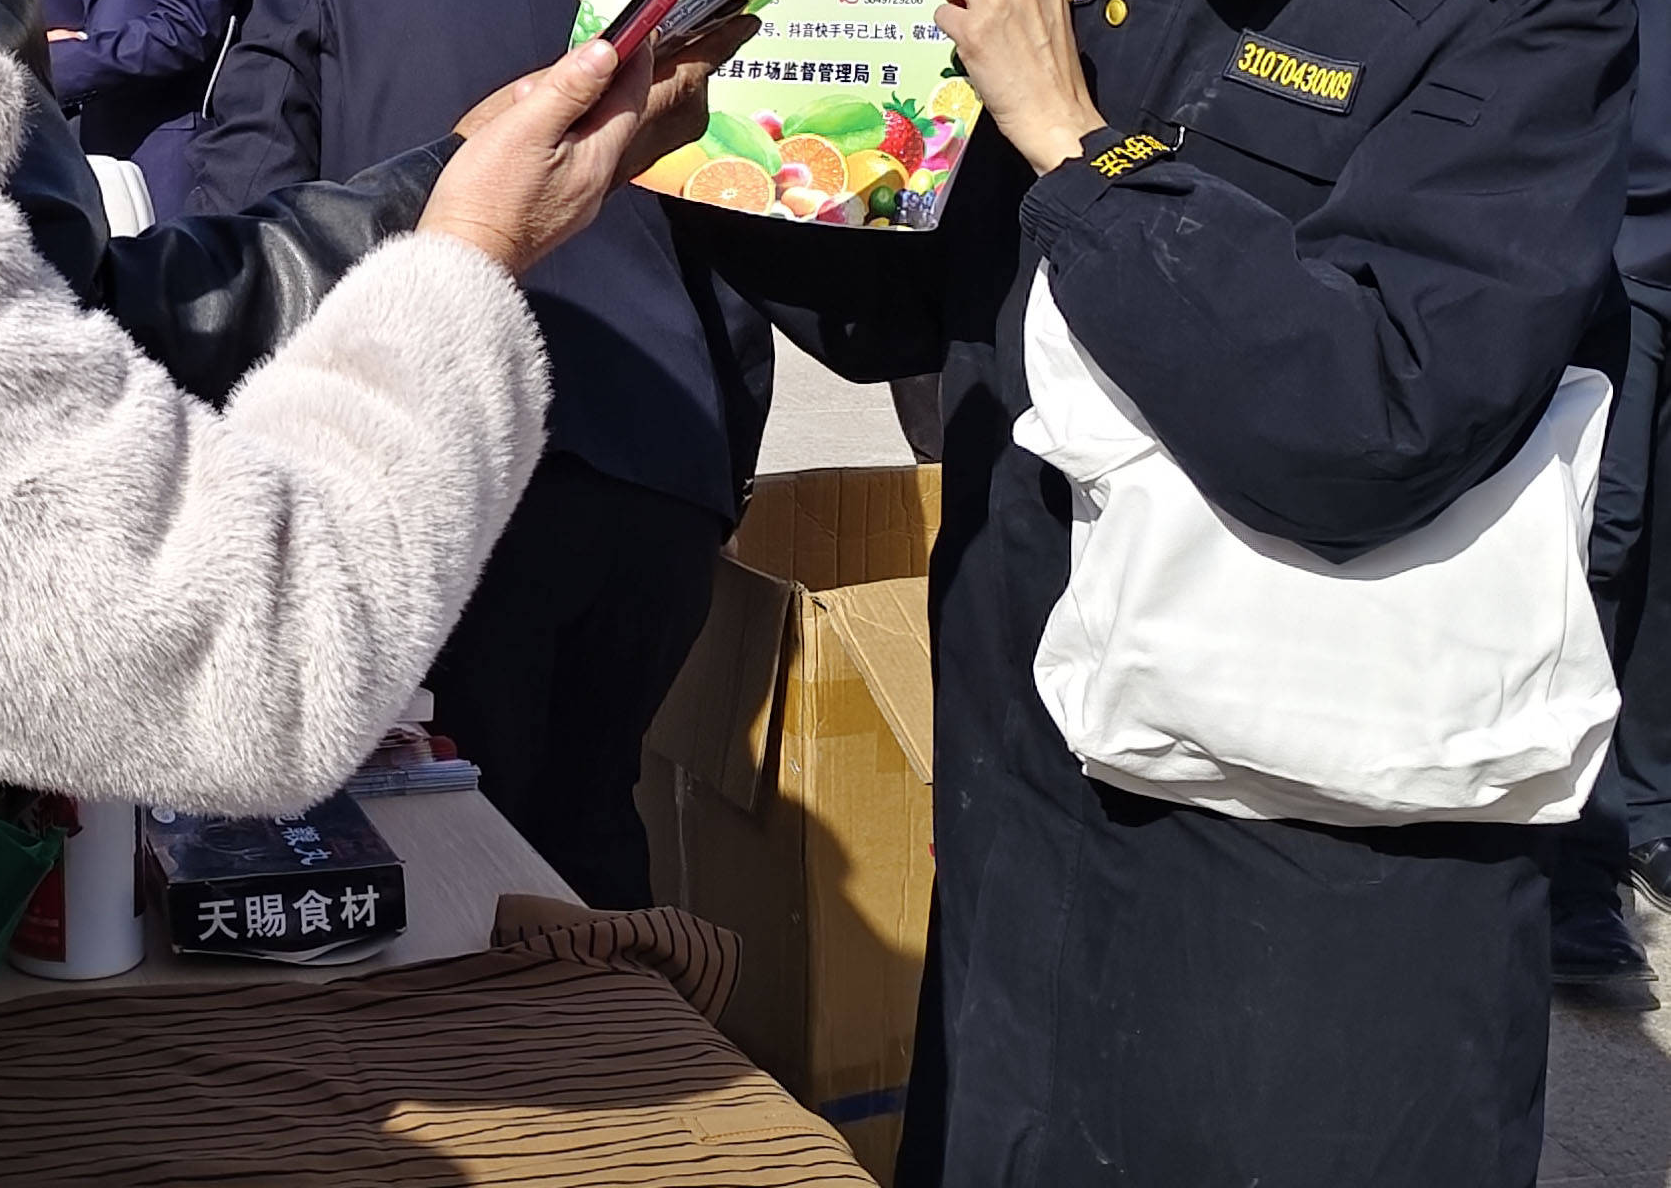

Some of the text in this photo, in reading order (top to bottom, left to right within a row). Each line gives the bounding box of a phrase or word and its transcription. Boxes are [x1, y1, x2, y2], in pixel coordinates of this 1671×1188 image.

[757, 22, 949, 41] 号、抖音快手号已上线，敬请
[881, 65, 899, 85] 宣
[197, 885, 380, 941] 天賜食材
